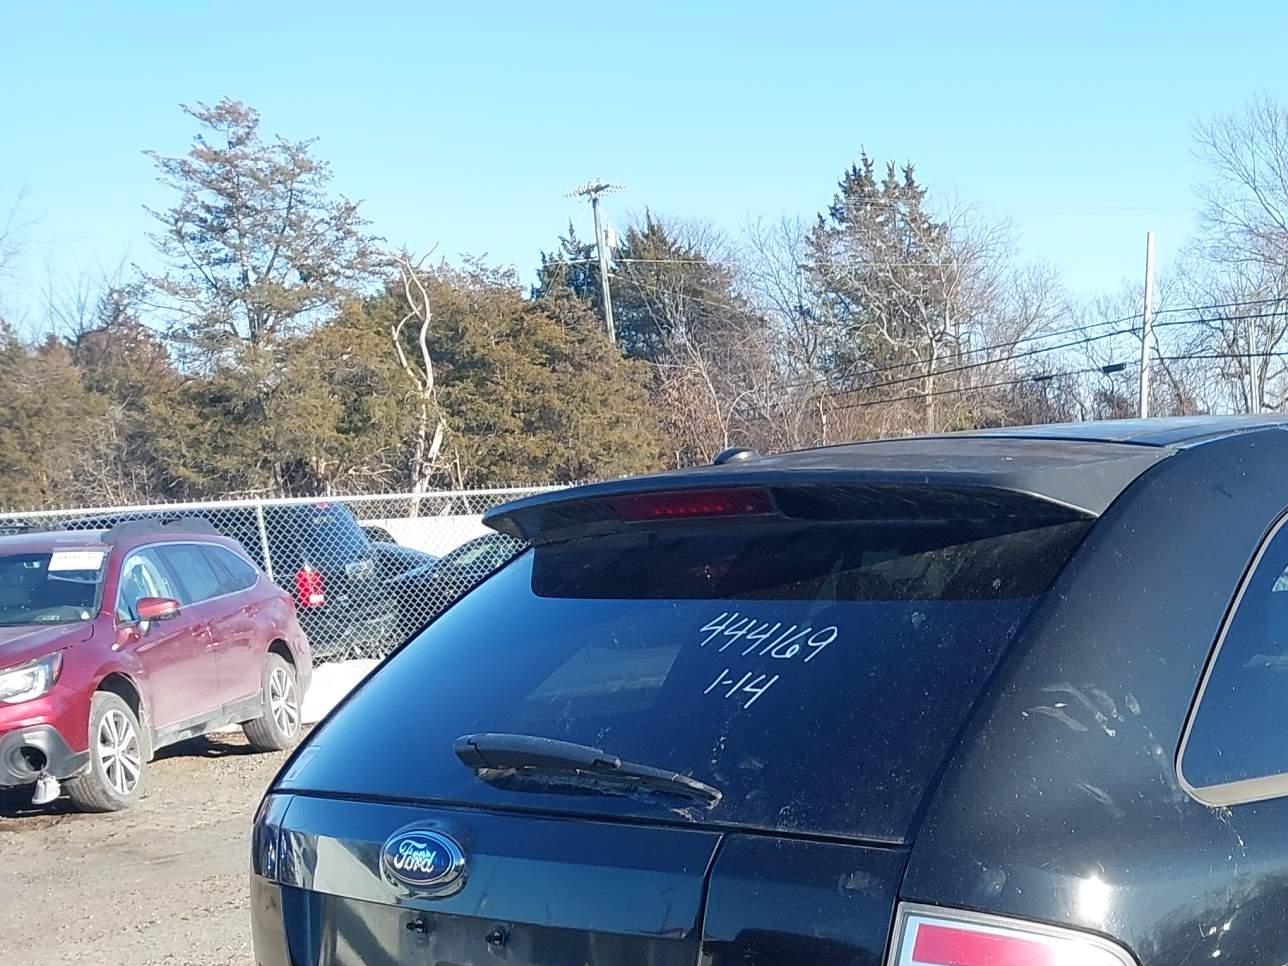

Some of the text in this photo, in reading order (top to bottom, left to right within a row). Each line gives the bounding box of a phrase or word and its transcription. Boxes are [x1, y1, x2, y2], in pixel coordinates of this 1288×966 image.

[700, 612, 838, 663] 444169
[703, 668, 780, 709] 1-14
[393, 839, 437, 873] Ford
